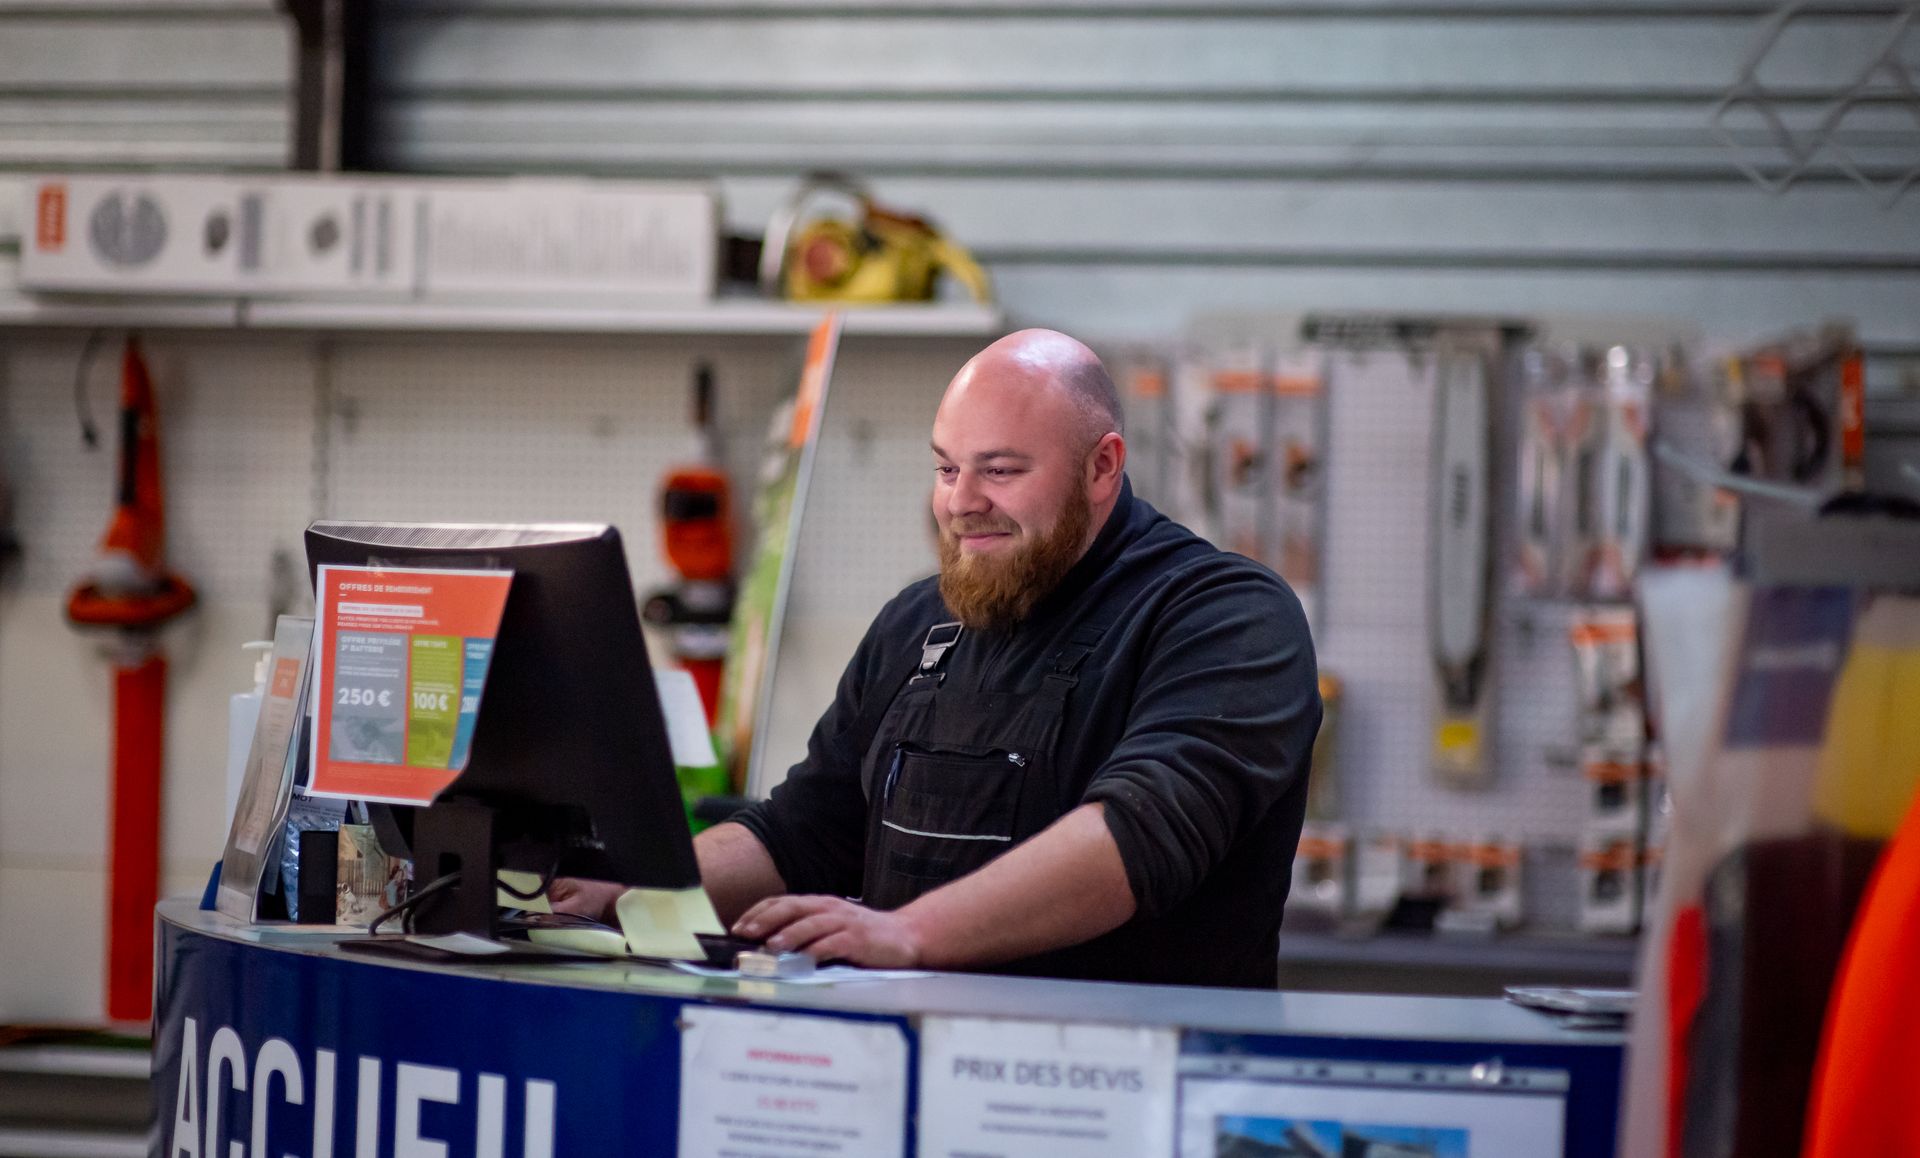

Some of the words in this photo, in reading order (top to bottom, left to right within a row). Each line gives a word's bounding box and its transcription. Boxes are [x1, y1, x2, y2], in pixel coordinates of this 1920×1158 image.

[339, 583, 372, 592] OFFRES
[374, 584, 385, 593] DE
[341, 636, 367, 645] OFFRE
[350, 645, 384, 654] BATTERIE
[338, 687, 375, 706] 250
[378, 689, 391, 707] €
[413, 692, 438, 711] 100
[439, 694, 449, 712] €
[952, 1056, 1006, 1083] PRIX
[1014, 1061, 1062, 1087] DES
[1069, 1066, 1143, 1093] DEVIS
